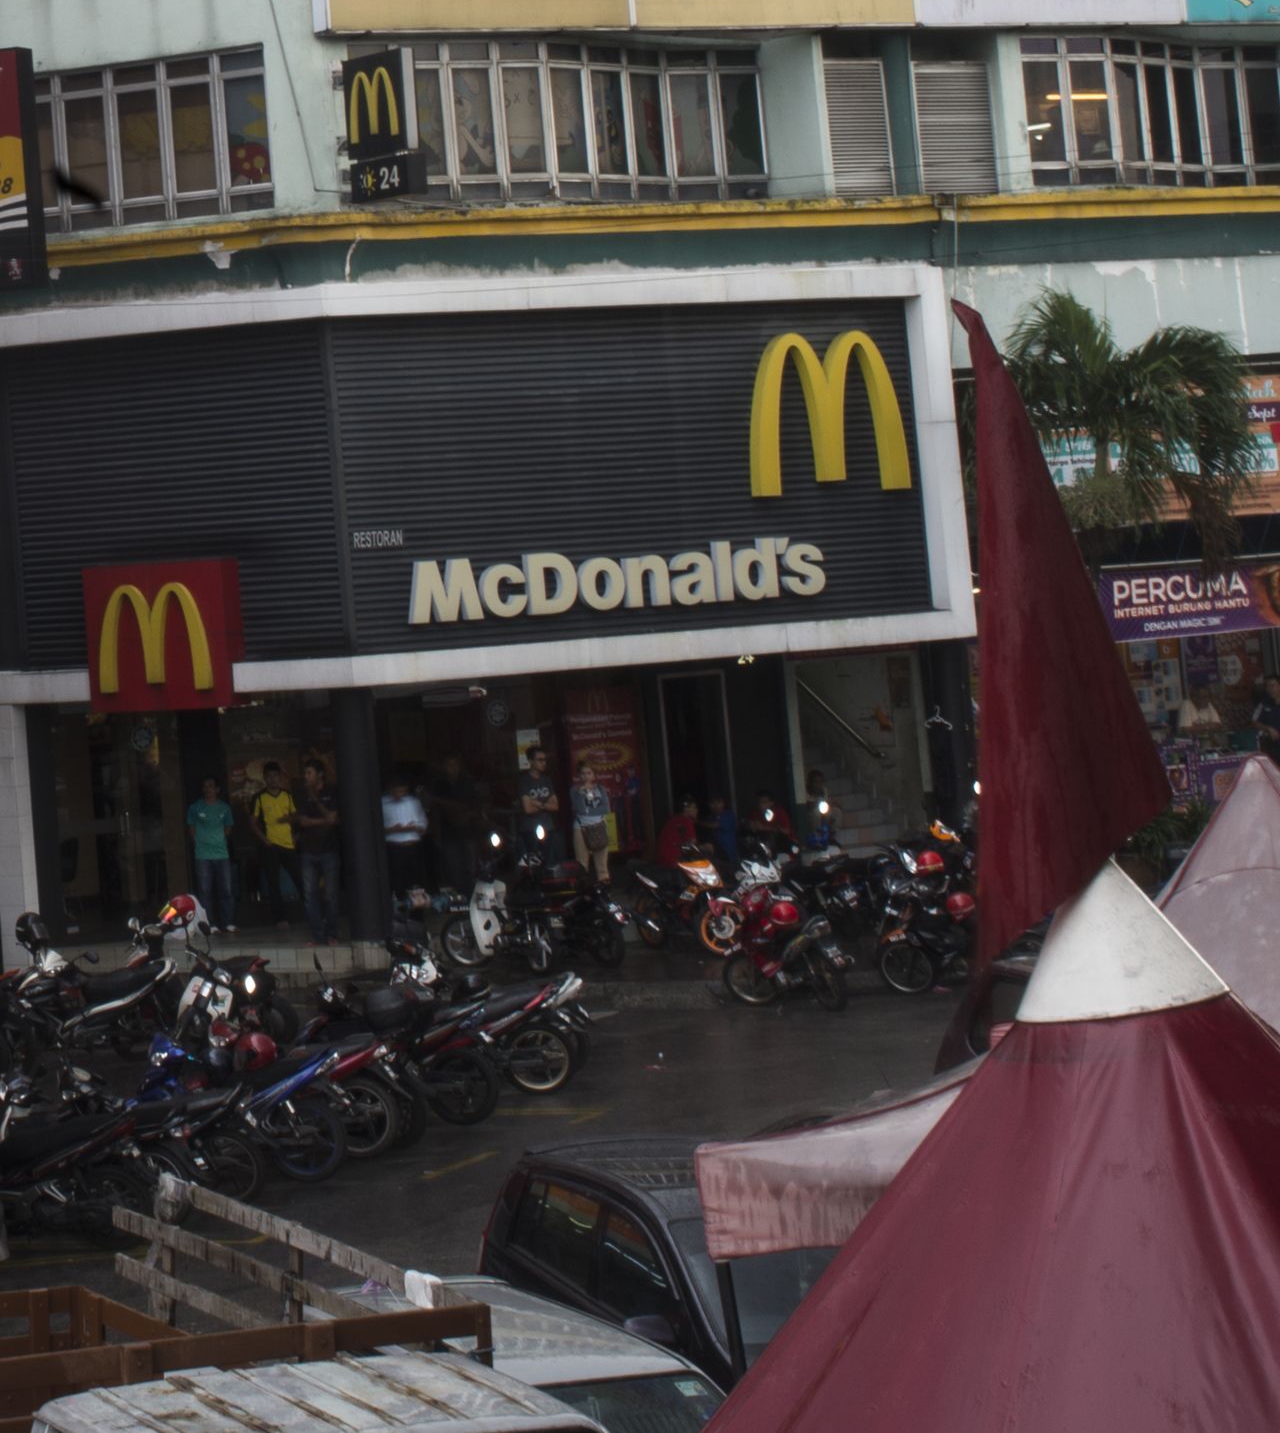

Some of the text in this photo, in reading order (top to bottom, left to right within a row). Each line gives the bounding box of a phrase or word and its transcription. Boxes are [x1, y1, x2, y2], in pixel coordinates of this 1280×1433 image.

[379, 164, 400, 190] 24
[353, 529, 403, 549] RESTORAN
[408, 537, 826, 626] McDonald's
[1112, 569, 1248, 607] PERCUMA
[1114, 597, 1251, 619] INTERNET BURUNG HANTU
[1144, 620, 1178, 633] DENGAN
